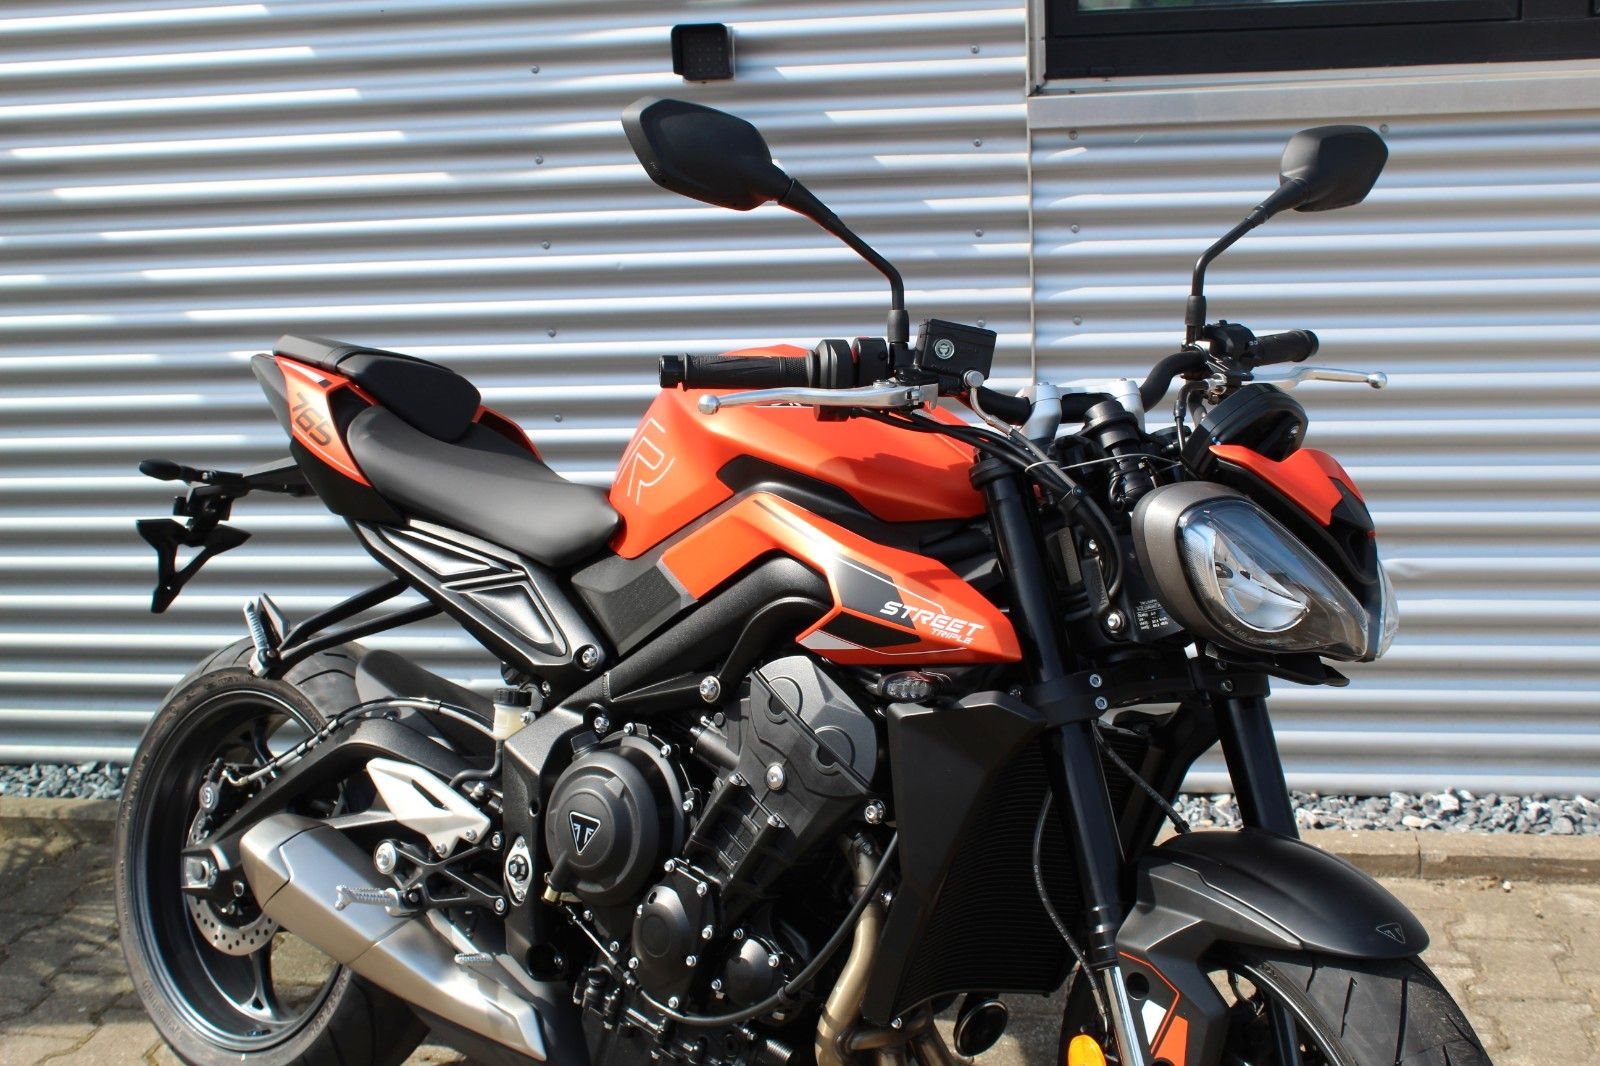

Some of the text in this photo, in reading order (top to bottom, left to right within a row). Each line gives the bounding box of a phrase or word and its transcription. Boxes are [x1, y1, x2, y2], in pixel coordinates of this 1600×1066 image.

[292, 391, 332, 446] 765
[611, 417, 676, 505] R
[879, 600, 985, 637] STREET
[931, 627, 974, 645] TRIPLE
